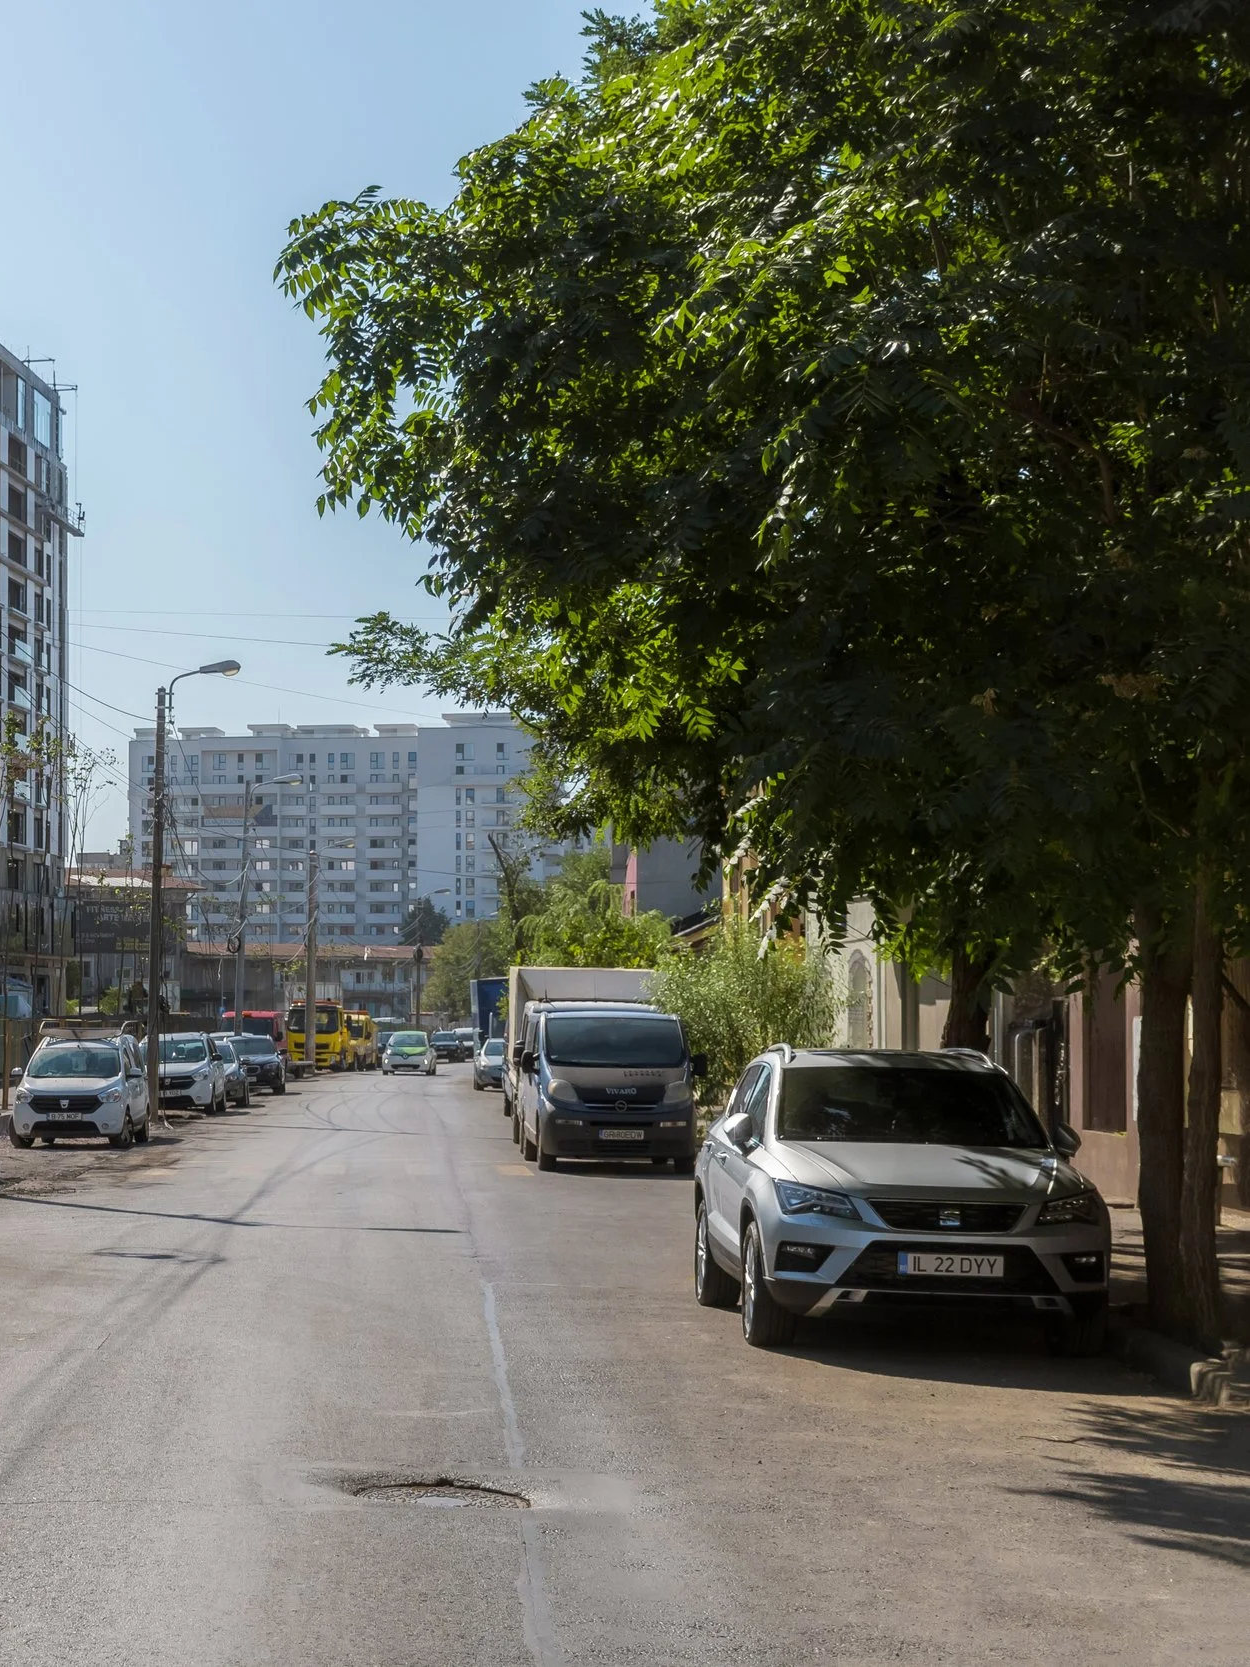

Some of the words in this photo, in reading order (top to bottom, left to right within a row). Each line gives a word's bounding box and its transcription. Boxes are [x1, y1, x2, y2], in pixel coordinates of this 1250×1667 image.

[913, 1256, 927, 1272] IL
[934, 1257, 954, 1273] 22
[960, 1258, 997, 1274] DYY
